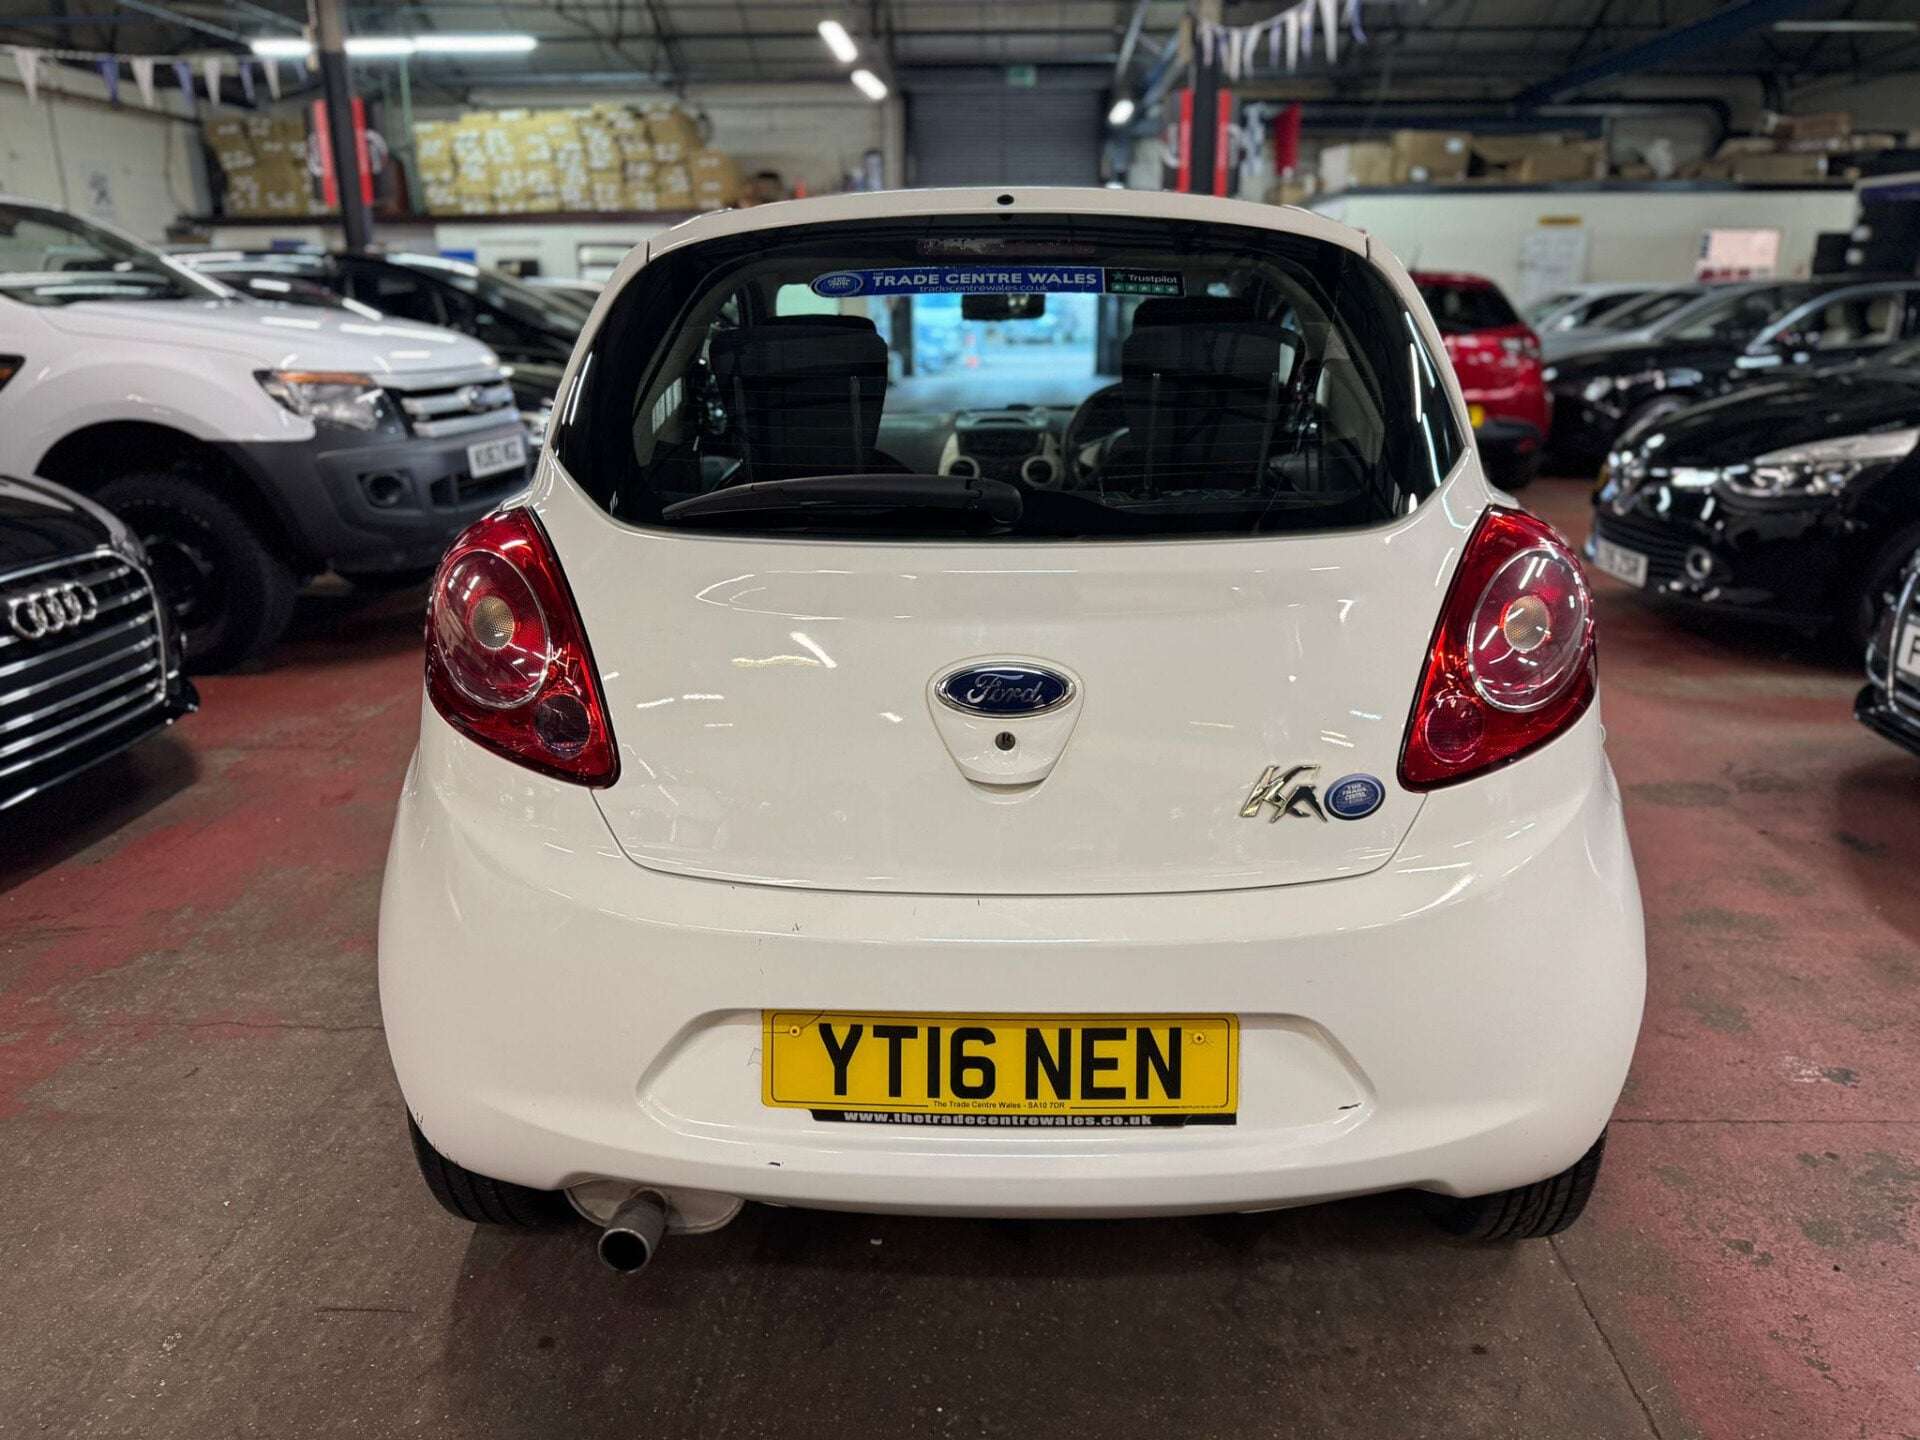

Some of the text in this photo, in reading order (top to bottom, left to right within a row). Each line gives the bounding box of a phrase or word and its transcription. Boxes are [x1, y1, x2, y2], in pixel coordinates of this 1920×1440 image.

[873, 272, 1097, 287] TRADE CENTRE WALES
[1128, 273, 1178, 284] Trustpilot
[919, 283, 1049, 293] tradecentrewales.co.uk
[967, 673, 1043, 704] Ford
[818, 1023, 1182, 1101] YT16 NEN
[934, 1100, 947, 1108] The
[950, 1101, 970, 1109] Trade
[972, 1101, 996, 1109] Centre
[999, 1101, 1021, 1110] Wales
[844, 1111, 1152, 1127] www.thetradecentrewales.co.uk
